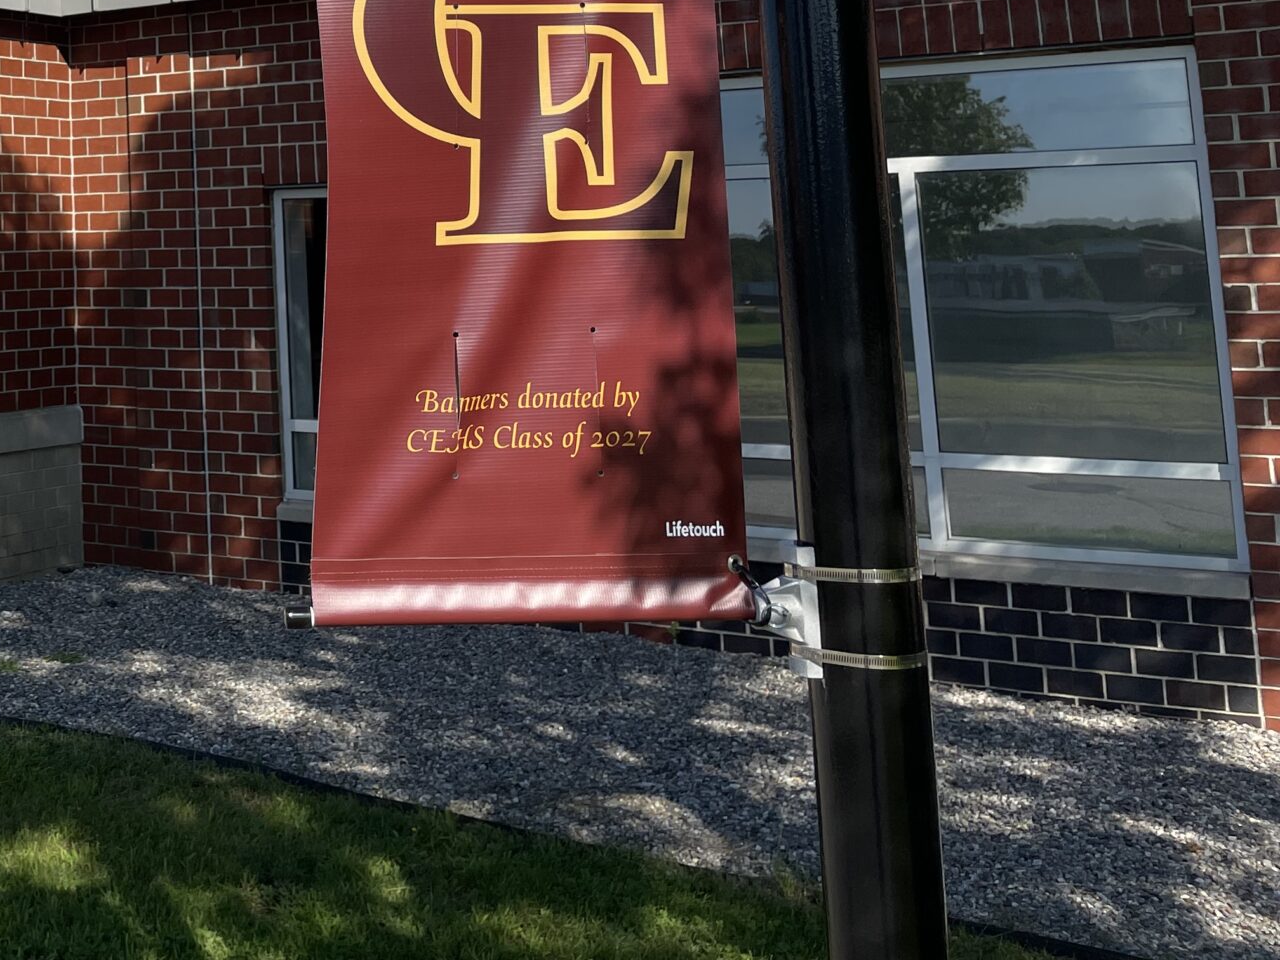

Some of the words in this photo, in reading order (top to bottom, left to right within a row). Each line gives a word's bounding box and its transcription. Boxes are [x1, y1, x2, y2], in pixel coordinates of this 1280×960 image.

[415, 388, 509, 414] Banners
[516, 381, 606, 410] donated
[613, 380, 640, 417] by
[492, 421, 554, 450] Class
[561, 420, 587, 458] of
[590, 429, 652, 455] 2027
[665, 520, 725, 537] Lifetouch
